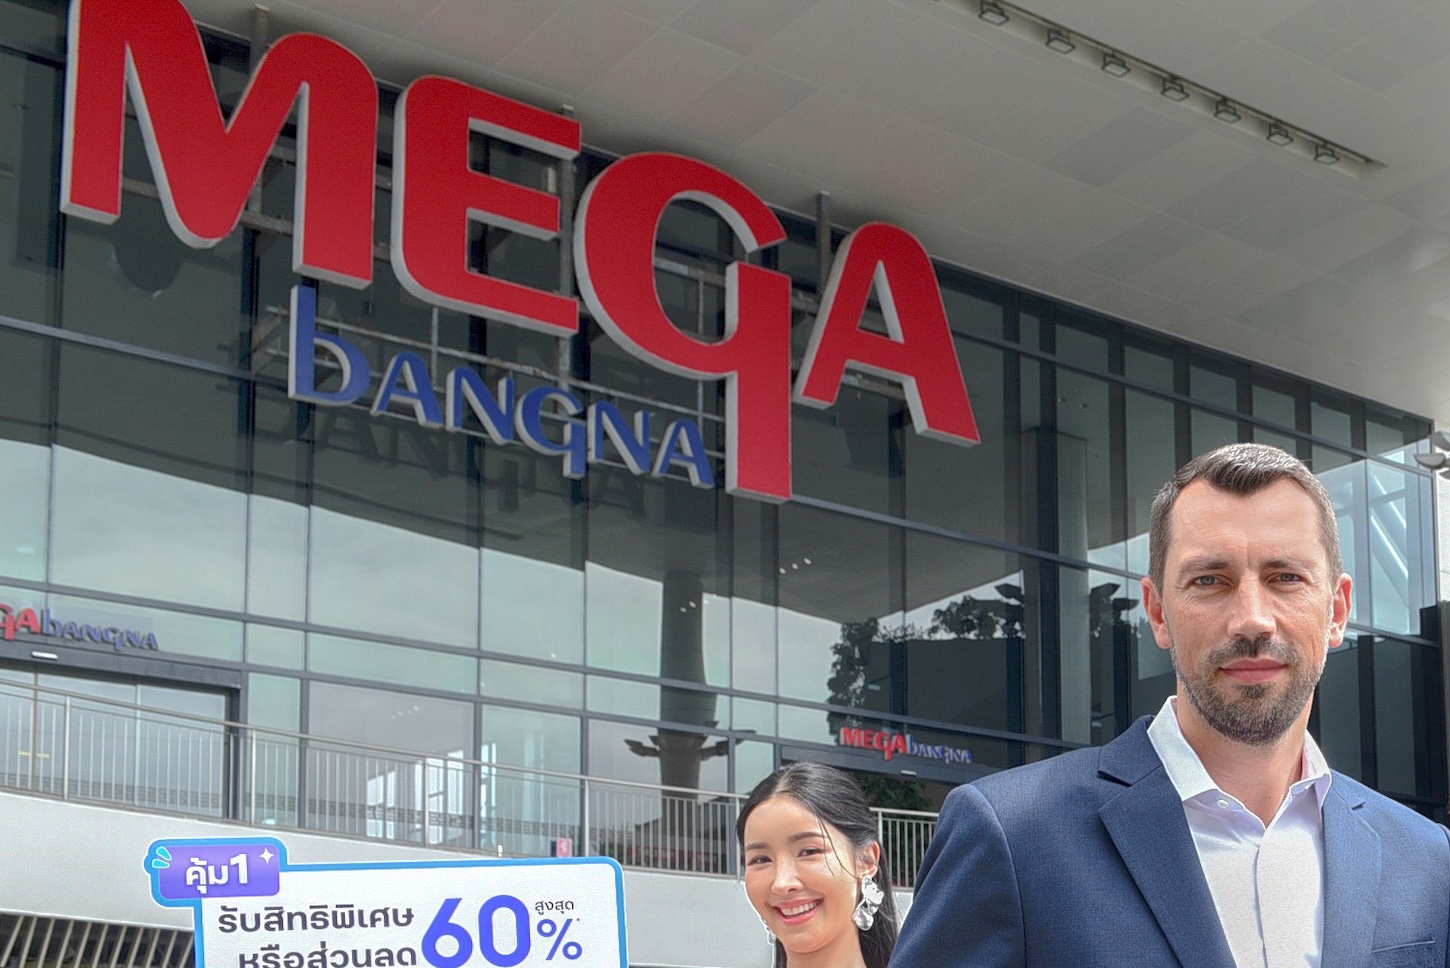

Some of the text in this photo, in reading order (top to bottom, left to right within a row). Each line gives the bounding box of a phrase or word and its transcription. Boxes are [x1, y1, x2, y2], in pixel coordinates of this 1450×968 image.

[60, 0, 980, 501] MEGA
[839, 725, 907, 762] MEGA
[185, 853, 249, 895] คุ้ม1
[217, 904, 415, 934] รับสิทธิพิเศษ
